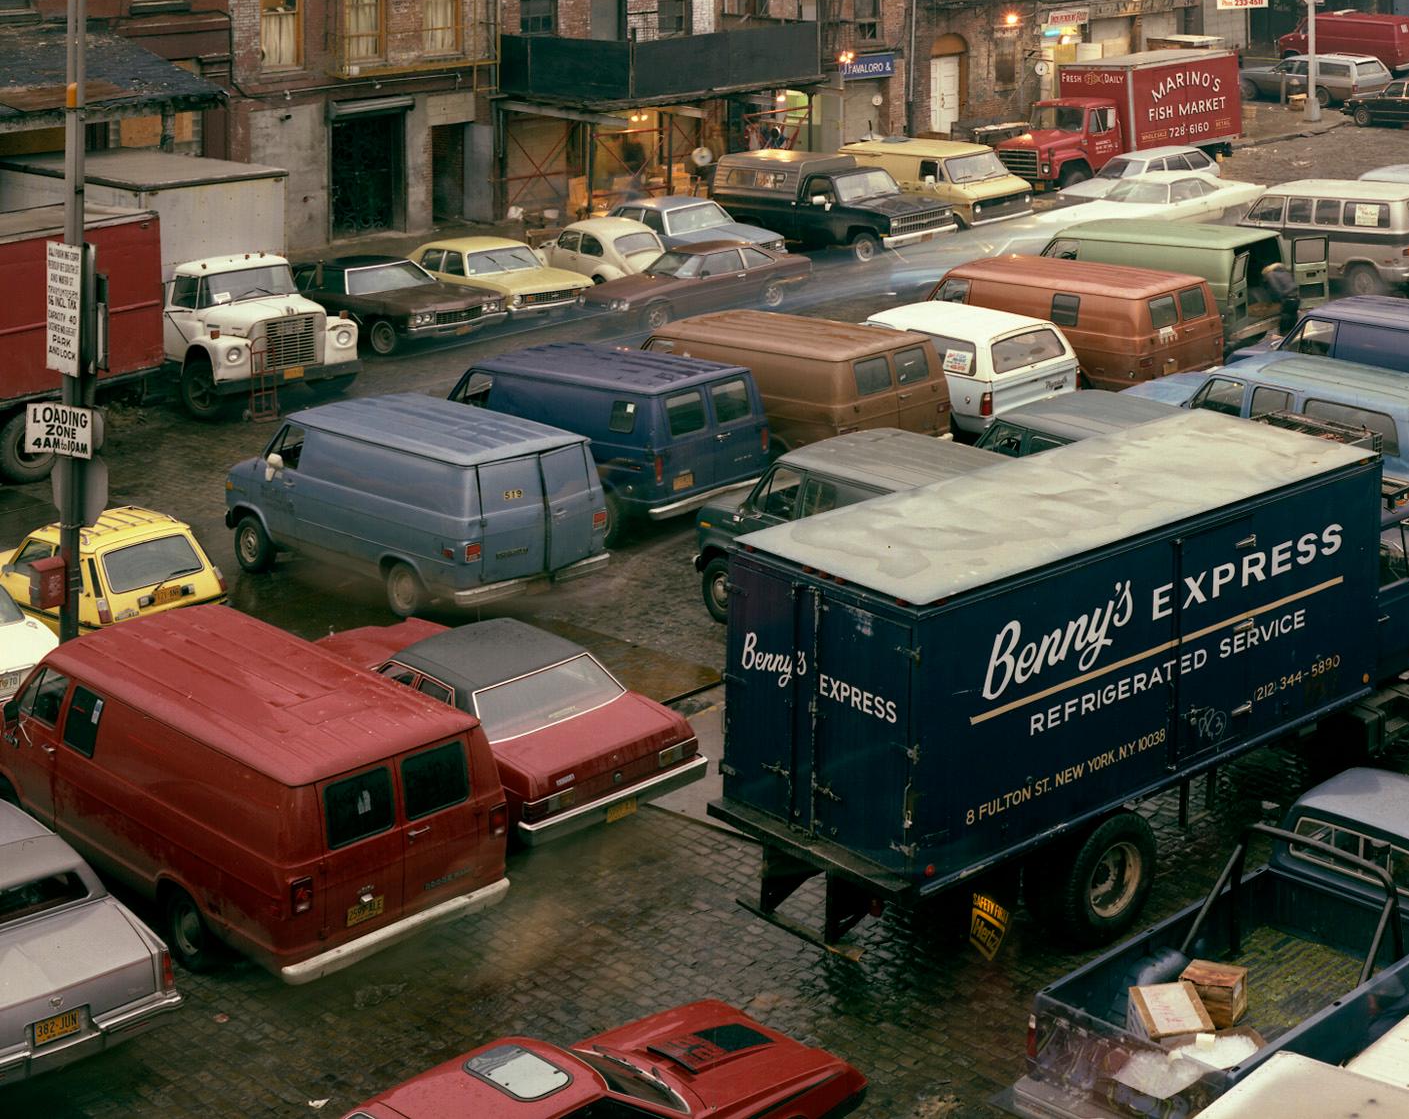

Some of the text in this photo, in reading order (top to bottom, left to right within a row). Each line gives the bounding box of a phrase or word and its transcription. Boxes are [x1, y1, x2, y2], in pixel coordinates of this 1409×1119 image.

[885, 62, 891, 71] &
[1061, 73, 1082, 83] FRESH
[1104, 73, 1124, 84] DAILY
[1151, 71, 1221, 103] MARINO'S
[1149, 96, 1226, 121] FISH MARKET
[52, 334, 71, 347] PARK
[60, 348, 76, 361] LOCK
[33, 407, 88, 429] LOADING
[45, 424, 76, 439] ZONE
[32, 437, 60, 449] 4AM
[67, 440, 88, 454] 10AM
[504, 490, 523, 500] 519
[982, 523, 1343, 700] Benny's EXPRESS
[742, 631, 897, 723] Benny's EXPRESS
[1030, 649, 1208, 736] REFRIGERATED
[1219, 609, 1306, 660] SERVICE
[1279, 654, 1341, 688] 344-5890
[966, 810, 975, 826] 8
[979, 785, 1032, 822] FULTON
[1055, 761, 1084, 787] NEW
[1138, 728, 1166, 752] 10038
[37, 1008, 80, 1038] 382-JUN
